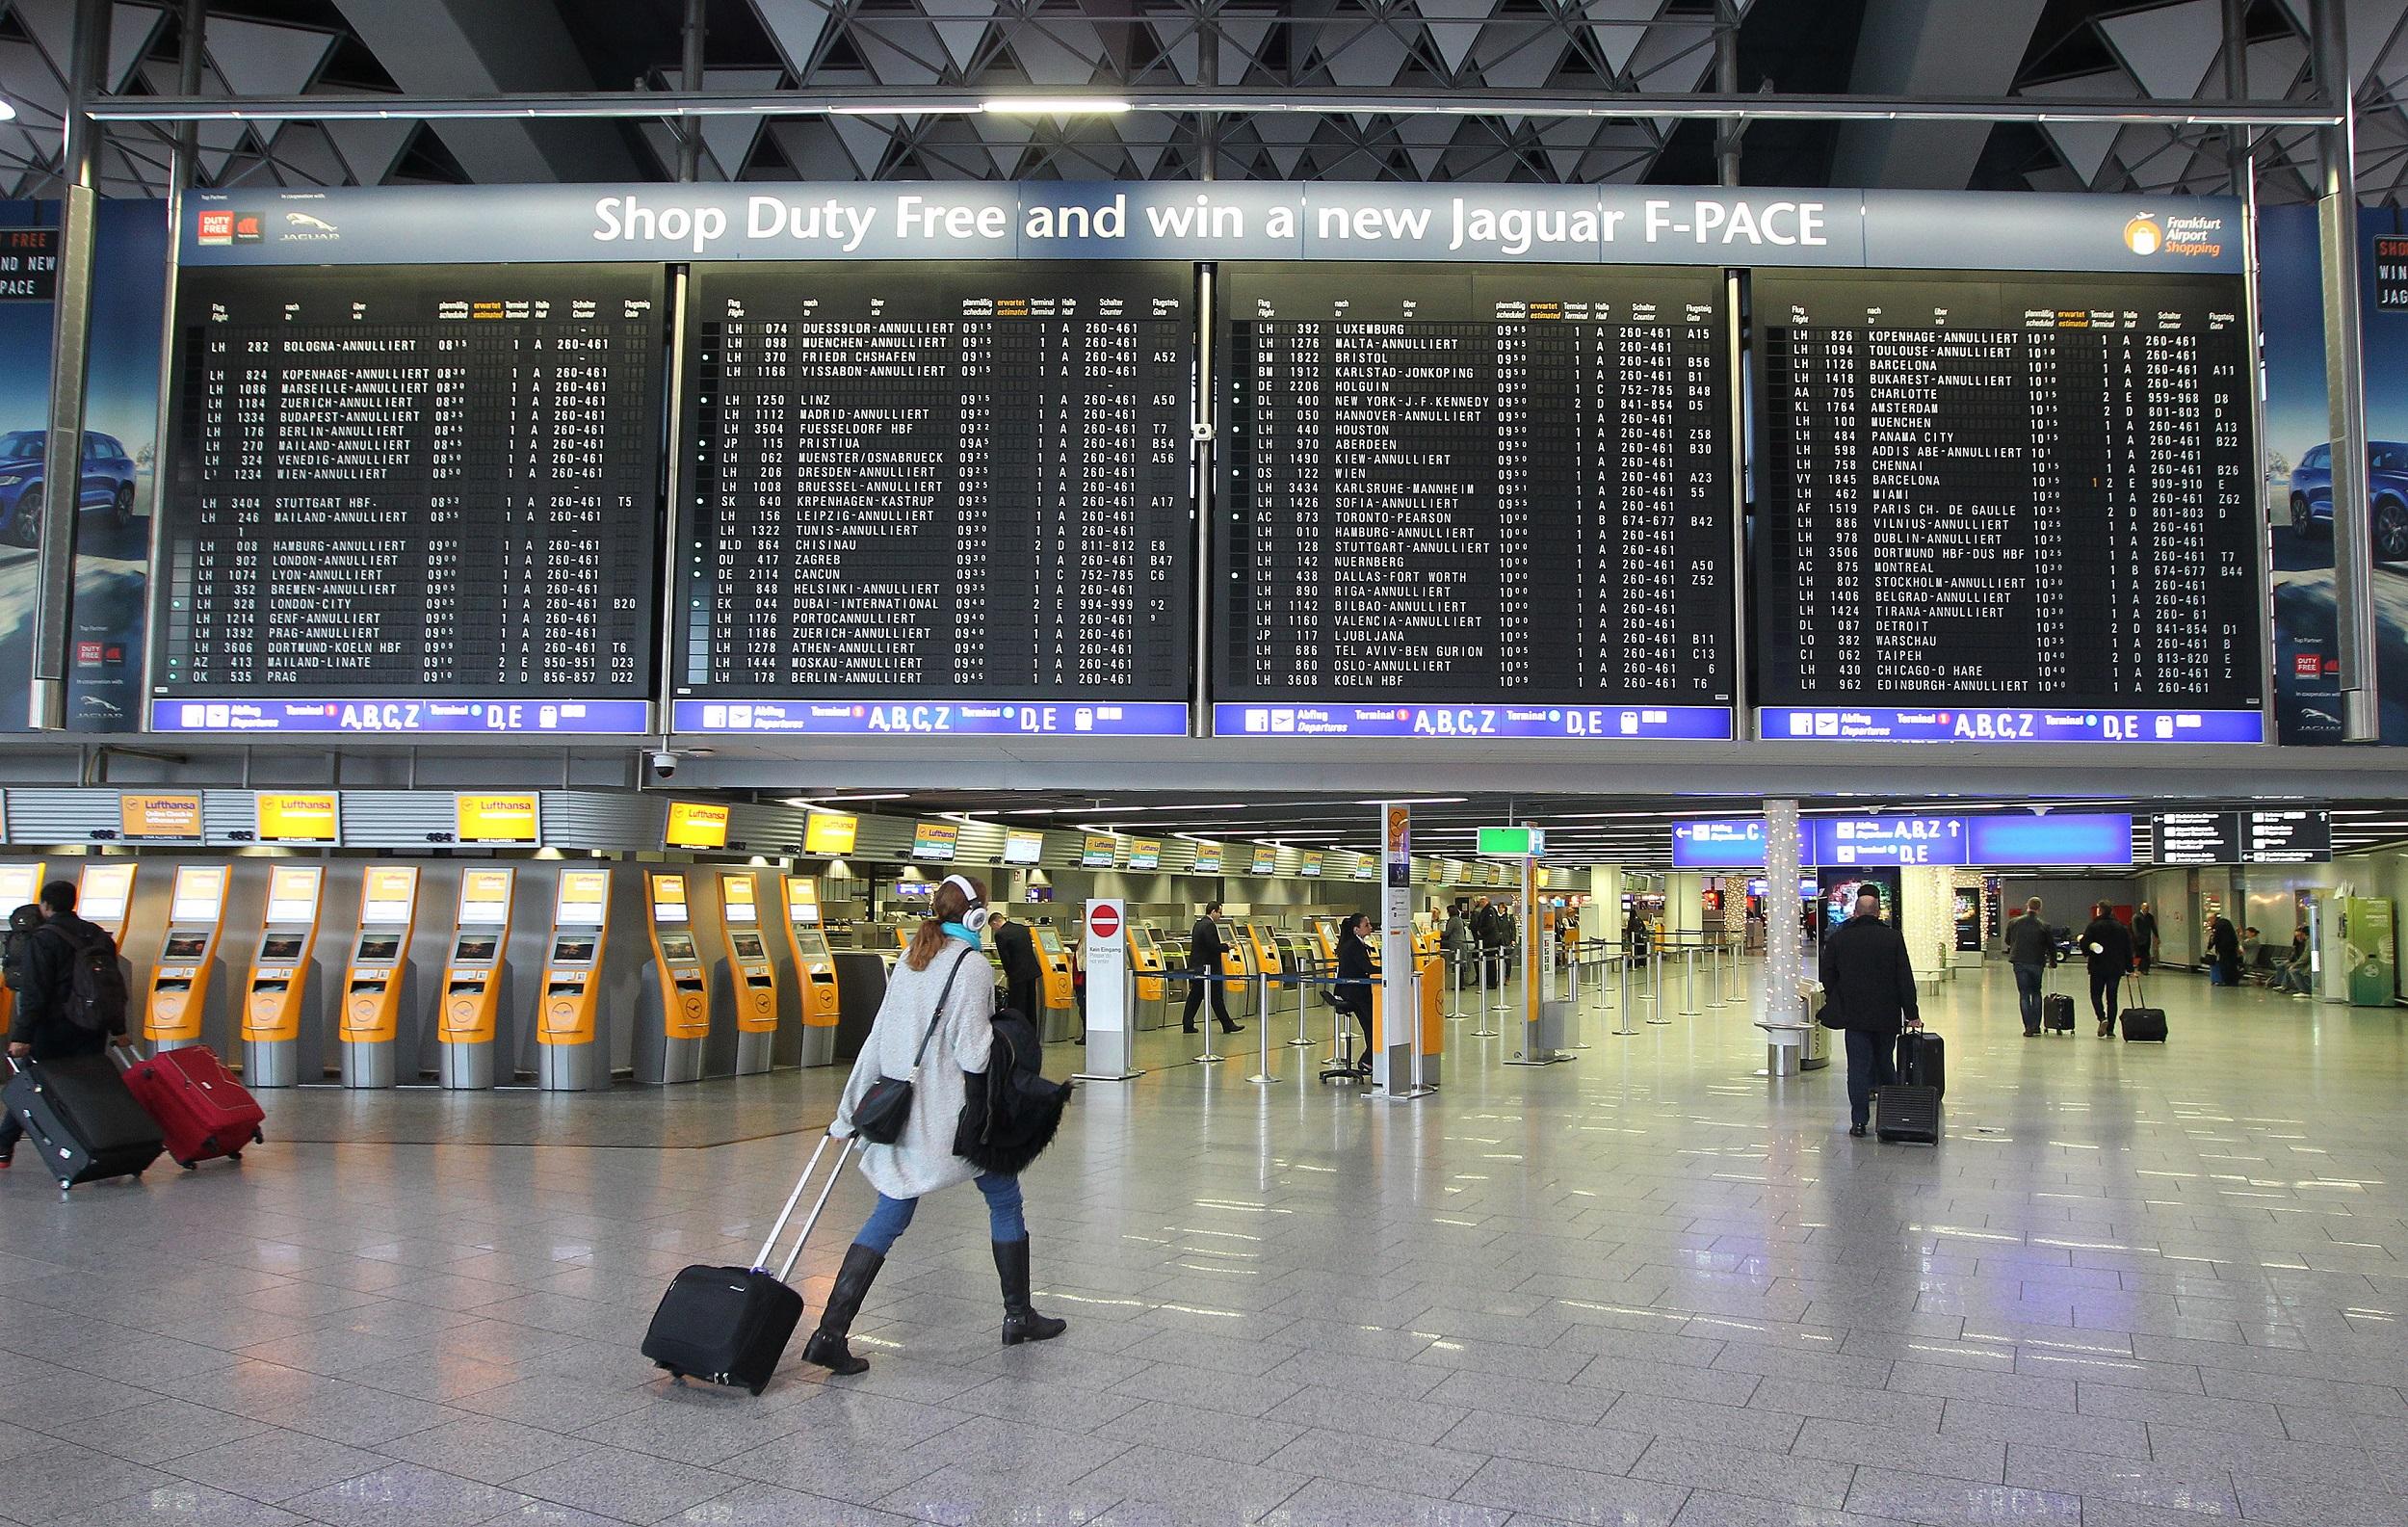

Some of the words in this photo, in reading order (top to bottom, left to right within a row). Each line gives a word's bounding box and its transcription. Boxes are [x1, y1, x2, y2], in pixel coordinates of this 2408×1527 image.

[203, 216, 230, 225] DUTY
[593, 196, 726, 252] Shop
[747, 196, 877, 251] Duty
[897, 196, 1006, 238] Free
[1024, 194, 1126, 239] and
[1146, 194, 1243, 238] win
[1265, 205, 1295, 238] a
[1319, 204, 1432, 239] new
[1449, 198, 1624, 255] Jaguar
[1645, 200, 1827, 246] F-PACE
[2167, 216, 2221, 230] Frankfurt
[203, 224, 228, 234] FREE
[12, 233, 46, 248] FREE
[2165, 229, 2207, 243] Airport
[2165, 241, 2221, 257] Shopping
[28, 255, 56, 272] NEW
[803, 299, 818, 307] nach
[963, 299, 993, 308] planmäßig
[997, 299, 1025, 307] erwartet
[1152, 299, 1179, 308] Flugsteig
[963, 307, 993, 316] scheduled
[997, 307, 1028, 316] estimated
[1031, 307, 1055, 316] Terminal
[1100, 307, 1123, 316] Counter
[1336, 324, 1405, 335] LUXEMBURG
[212, 342, 226, 353] LH
[248, 342, 270, 352] 282
[284, 340, 416, 352] BOLOGNA-ANNULLIERT
[514, 339, 519, 350] 1
[535, 339, 542, 350] A
[558, 339, 609, 350] 260-461
[1870, 359, 1938, 370] BARCELONA
[282, 369, 431, 380] KOPENHAGE-ANNULLIERT
[1336, 367, 1474, 378] KARLSTAD-JONKOPING
[1871, 374, 2012, 385] BUKAREST-ANNULLIERT
[281, 397, 413, 408] ZUERICH-ANNULLIERT
[801, 395, 830, 405] LINZ
[1336, 396, 1358, 406] NEW
[1367, 396, 1489, 407] YORK-J.F.KENNEDY
[1871, 403, 1939, 413] AMSTERDAM
[280, 411, 421, 422] BUDAPEST-ANNULLIERT
[800, 409, 929, 419] MADRID-ANNULLIERT
[892, 424, 913, 434] HBF
[1336, 425, 1389, 434] HOUSTON
[1872, 432, 1917, 441] PANAMA
[1924, 432, 1954, 442] CITY
[278, 455, 410, 465] VENEDIG-ANNULLIERT
[798, 453, 944, 462] MUENSTER/OSNABRUECK
[1336, 454, 1452, 464] KIEW-ANNULLIERT
[1872, 461, 1923, 470] CHENNAI
[1873, 489, 1909, 499] MIAMI
[275, 498, 342, 508] STUTTGART
[350, 497, 377, 508] HBF.
[1873, 504, 1911, 513] PARIS
[1920, 504, 1940, 514] CH.
[1950, 505, 1964, 514] DE
[1972, 505, 2017, 515] GAULLE
[798, 511, 934, 520] LEIPZIG-ANNULLIERT
[1336, 513, 1452, 523] TORONTO-PEARSON
[796, 540, 856, 550] CHISINAU
[796, 555, 841, 565] ZAGREB
[1875, 562, 1934, 572] MONTREAL
[273, 569, 383, 580] LYON-ANNULLIERT
[1258, 571, 1272, 581] LH
[1296, 571, 1319, 581] 438
[1335, 571, 1421, 582] DALLAS-FORT
[1428, 572, 1467, 582] WORTH
[1578, 573, 1583, 583] 1
[1599, 574, 1607, 583] A
[1623, 574, 1675, 585] 260-461
[1692, 575, 1714, 585] Z52
[271, 597, 352, 609] LONDON-CITY
[794, 598, 939, 609] DUBAI-INTERNATIONAL
[1876, 621, 1929, 631] DETROIT
[1335, 631, 1405, 641] LJUBLJANA
[268, 642, 373, 653] DORTMUND-KOELN
[380, 643, 402, 652] HBF
[793, 643, 916, 653] ATHEN-ANNULLIERT
[1335, 645, 1357, 655] TEL
[1366, 645, 1428, 656] AVIV-BEN
[1437, 646, 1483, 656] GURION
[1877, 650, 1923, 661] TAIPEH
[268, 656, 371, 668] MAILAND-LINATE
[268, 670, 298, 682] PRAG
[792, 672, 923, 683] BERLIN-ANNULLIERT
[1335, 675, 1374, 685] KOELN
[1382, 675, 1403, 686] HBF
[1878, 679, 2028, 691] EDINBURGH-ANNULLIERT
[340, 704, 419, 730] A,B,C,Z
[486, 704, 522, 730] D,E
[868, 705, 950, 732] A,B,C,Z
[1020, 707, 1056, 733] D,E
[1297, 709, 1328, 722] Abflug
[1355, 709, 1395, 721] Terminal
[1413, 709, 1495, 735] A,B,C,Z
[1506, 709, 1546, 722] Terminal
[1566, 710, 1603, 736] D,E
[1297, 723, 1348, 734] Departures
[1954, 713, 2033, 739] A,B,C,Z
[2103, 715, 2138, 741] D,E
[144, 800, 196, 810] Lufthansa
[281, 800, 331, 809] Lufthansa
[481, 801, 531, 810] Lufthansa
[688, 808, 725, 819] Lufthansa
[929, 829, 955, 838] Lufthansa
[1746, 824, 1759, 841] C
[1894, 821, 1940, 841] A,B,Z
[1899, 845, 1927, 864] D,E
